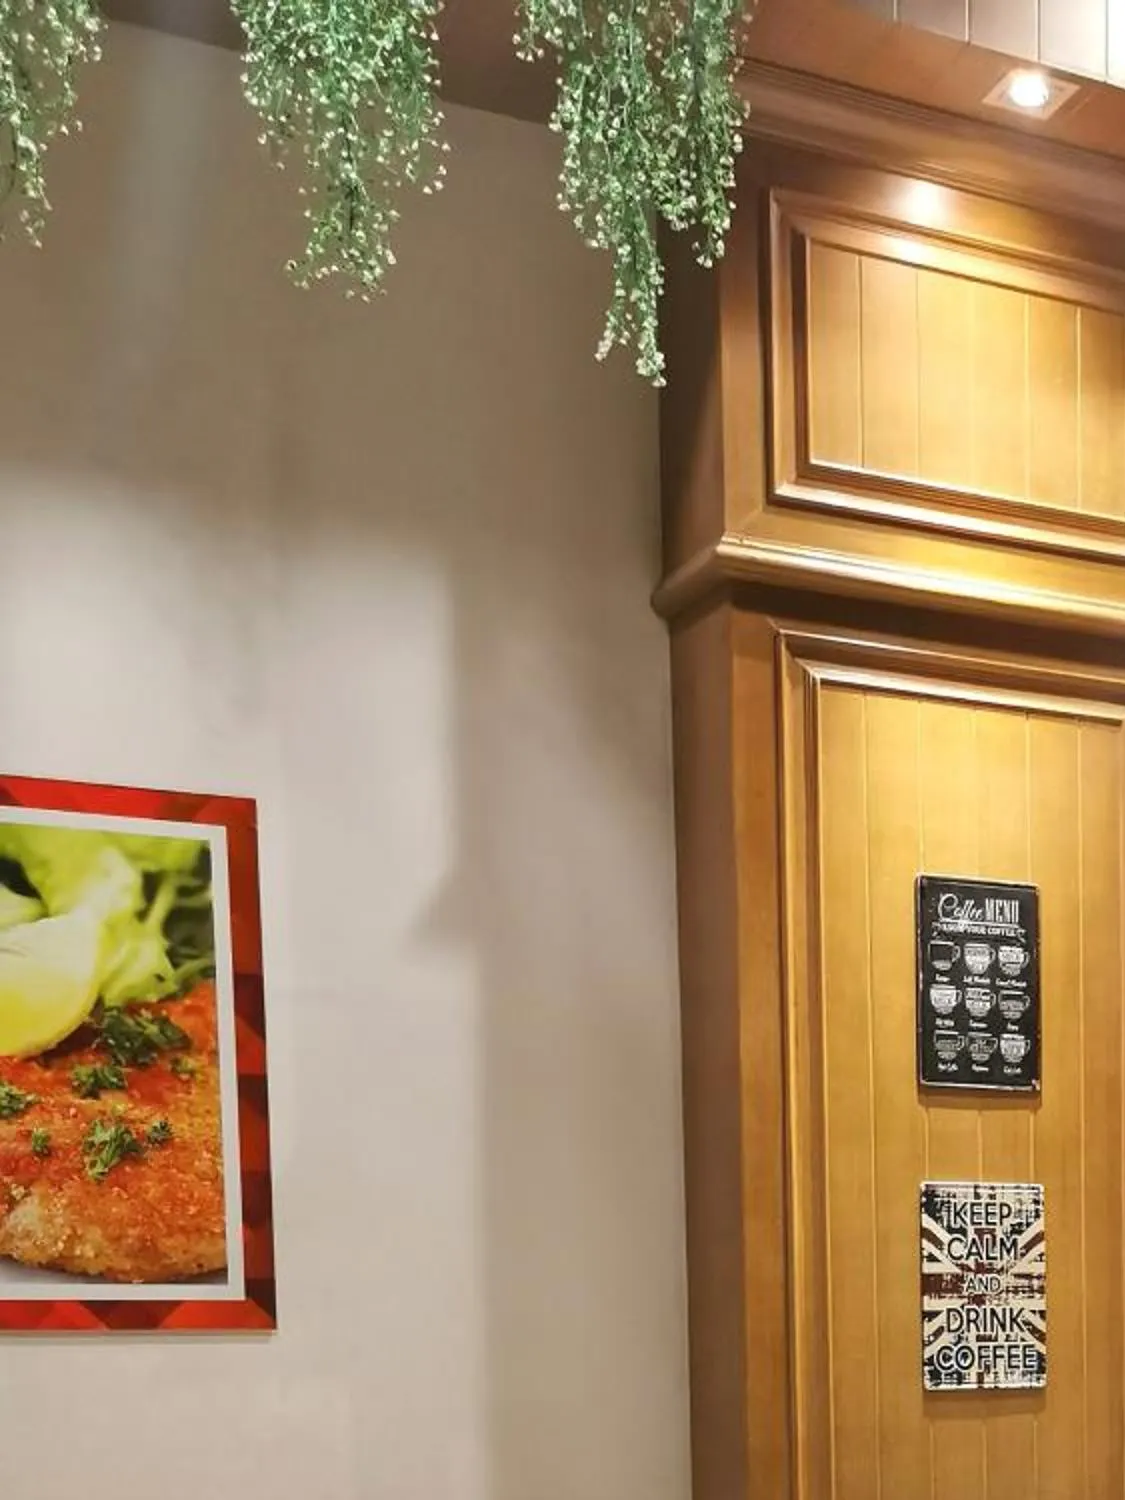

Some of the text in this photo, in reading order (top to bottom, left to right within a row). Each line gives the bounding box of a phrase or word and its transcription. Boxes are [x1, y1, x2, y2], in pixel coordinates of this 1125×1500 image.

[938, 893, 1020, 923] Coffee MENU
[952, 1201, 1012, 1226] KEEP
[947, 1237, 1019, 1261] CALM
[965, 1276, 1001, 1292] AND
[945, 1307, 1026, 1334] DRINK
[935, 1344, 1037, 1370] COFFEE
